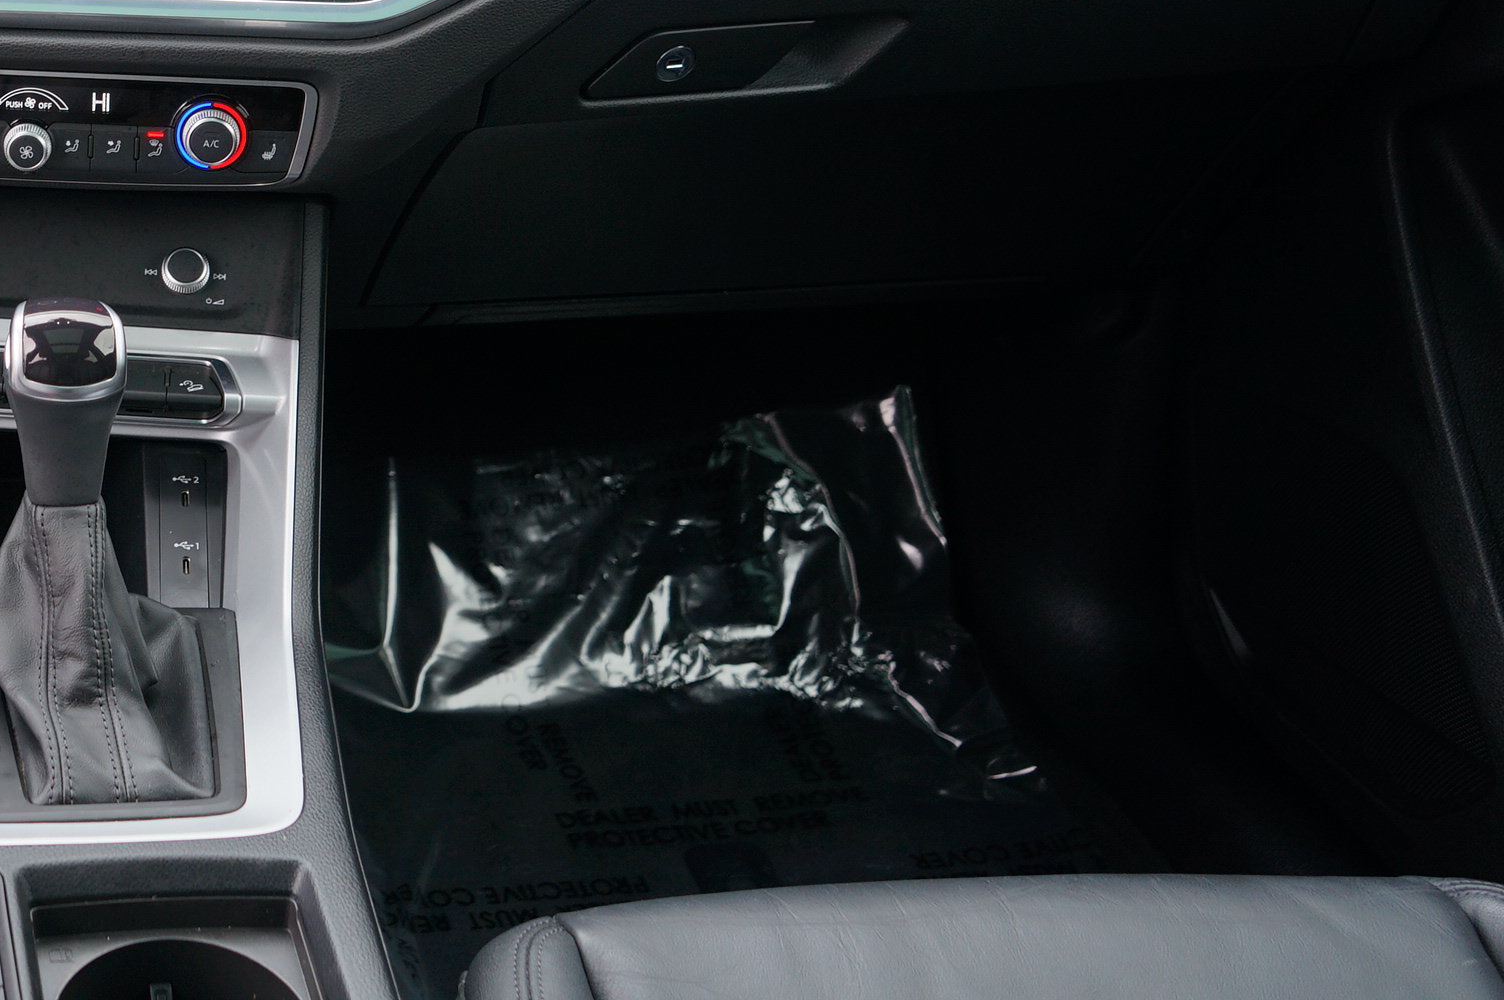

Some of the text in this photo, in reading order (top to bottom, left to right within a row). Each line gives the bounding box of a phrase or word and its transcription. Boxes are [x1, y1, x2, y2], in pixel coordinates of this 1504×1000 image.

[5, 101, 53, 110] PUSH OFF
[91, 92, 111, 113] HI
[202, 139, 220, 149] A/C
[193, 476, 199, 484] 2
[195, 542, 200, 550] 1
[556, 785, 871, 830] DEALER MUST REMOVE
[567, 809, 832, 851] PROTECTIVE COVER
[909, 843, 1009, 870] COVER
[481, 875, 651, 905] PROTECTIVE
